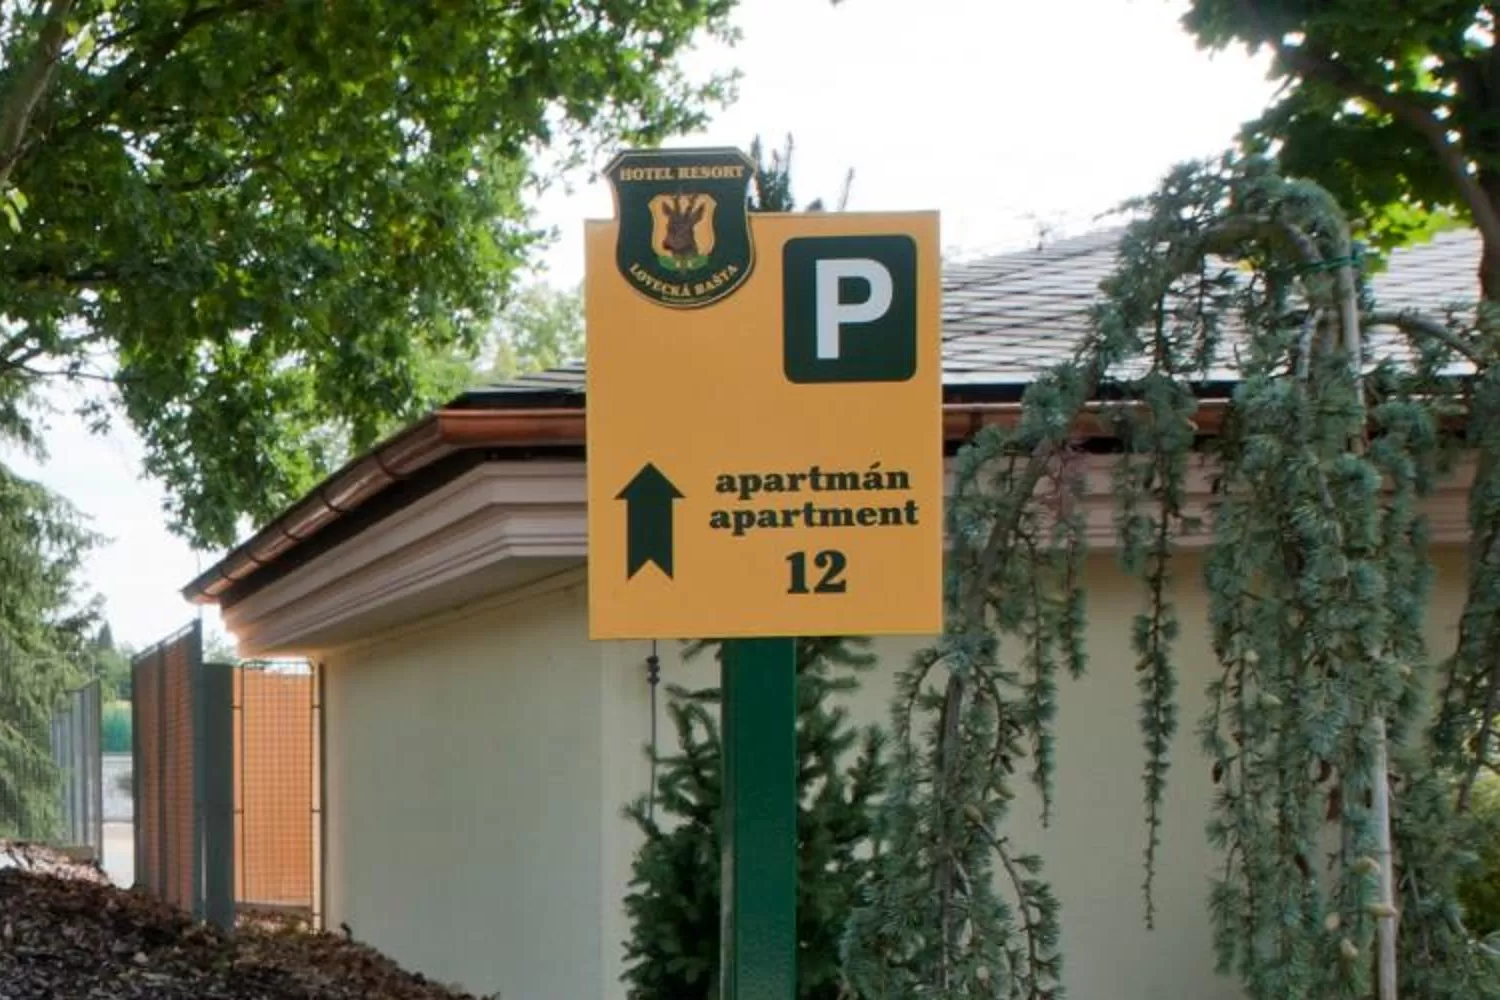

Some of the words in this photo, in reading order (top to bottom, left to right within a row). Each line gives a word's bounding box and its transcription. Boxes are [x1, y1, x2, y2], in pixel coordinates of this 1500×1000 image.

[620, 167, 675, 181] HOTEL
[677, 165, 745, 180] RESORT
[629, 262, 691, 297] LOVECKÁ
[815, 258, 893, 360] P
[715, 461, 910, 500] apartmán
[709, 500, 920, 536] apartment
[785, 549, 847, 595] 12
